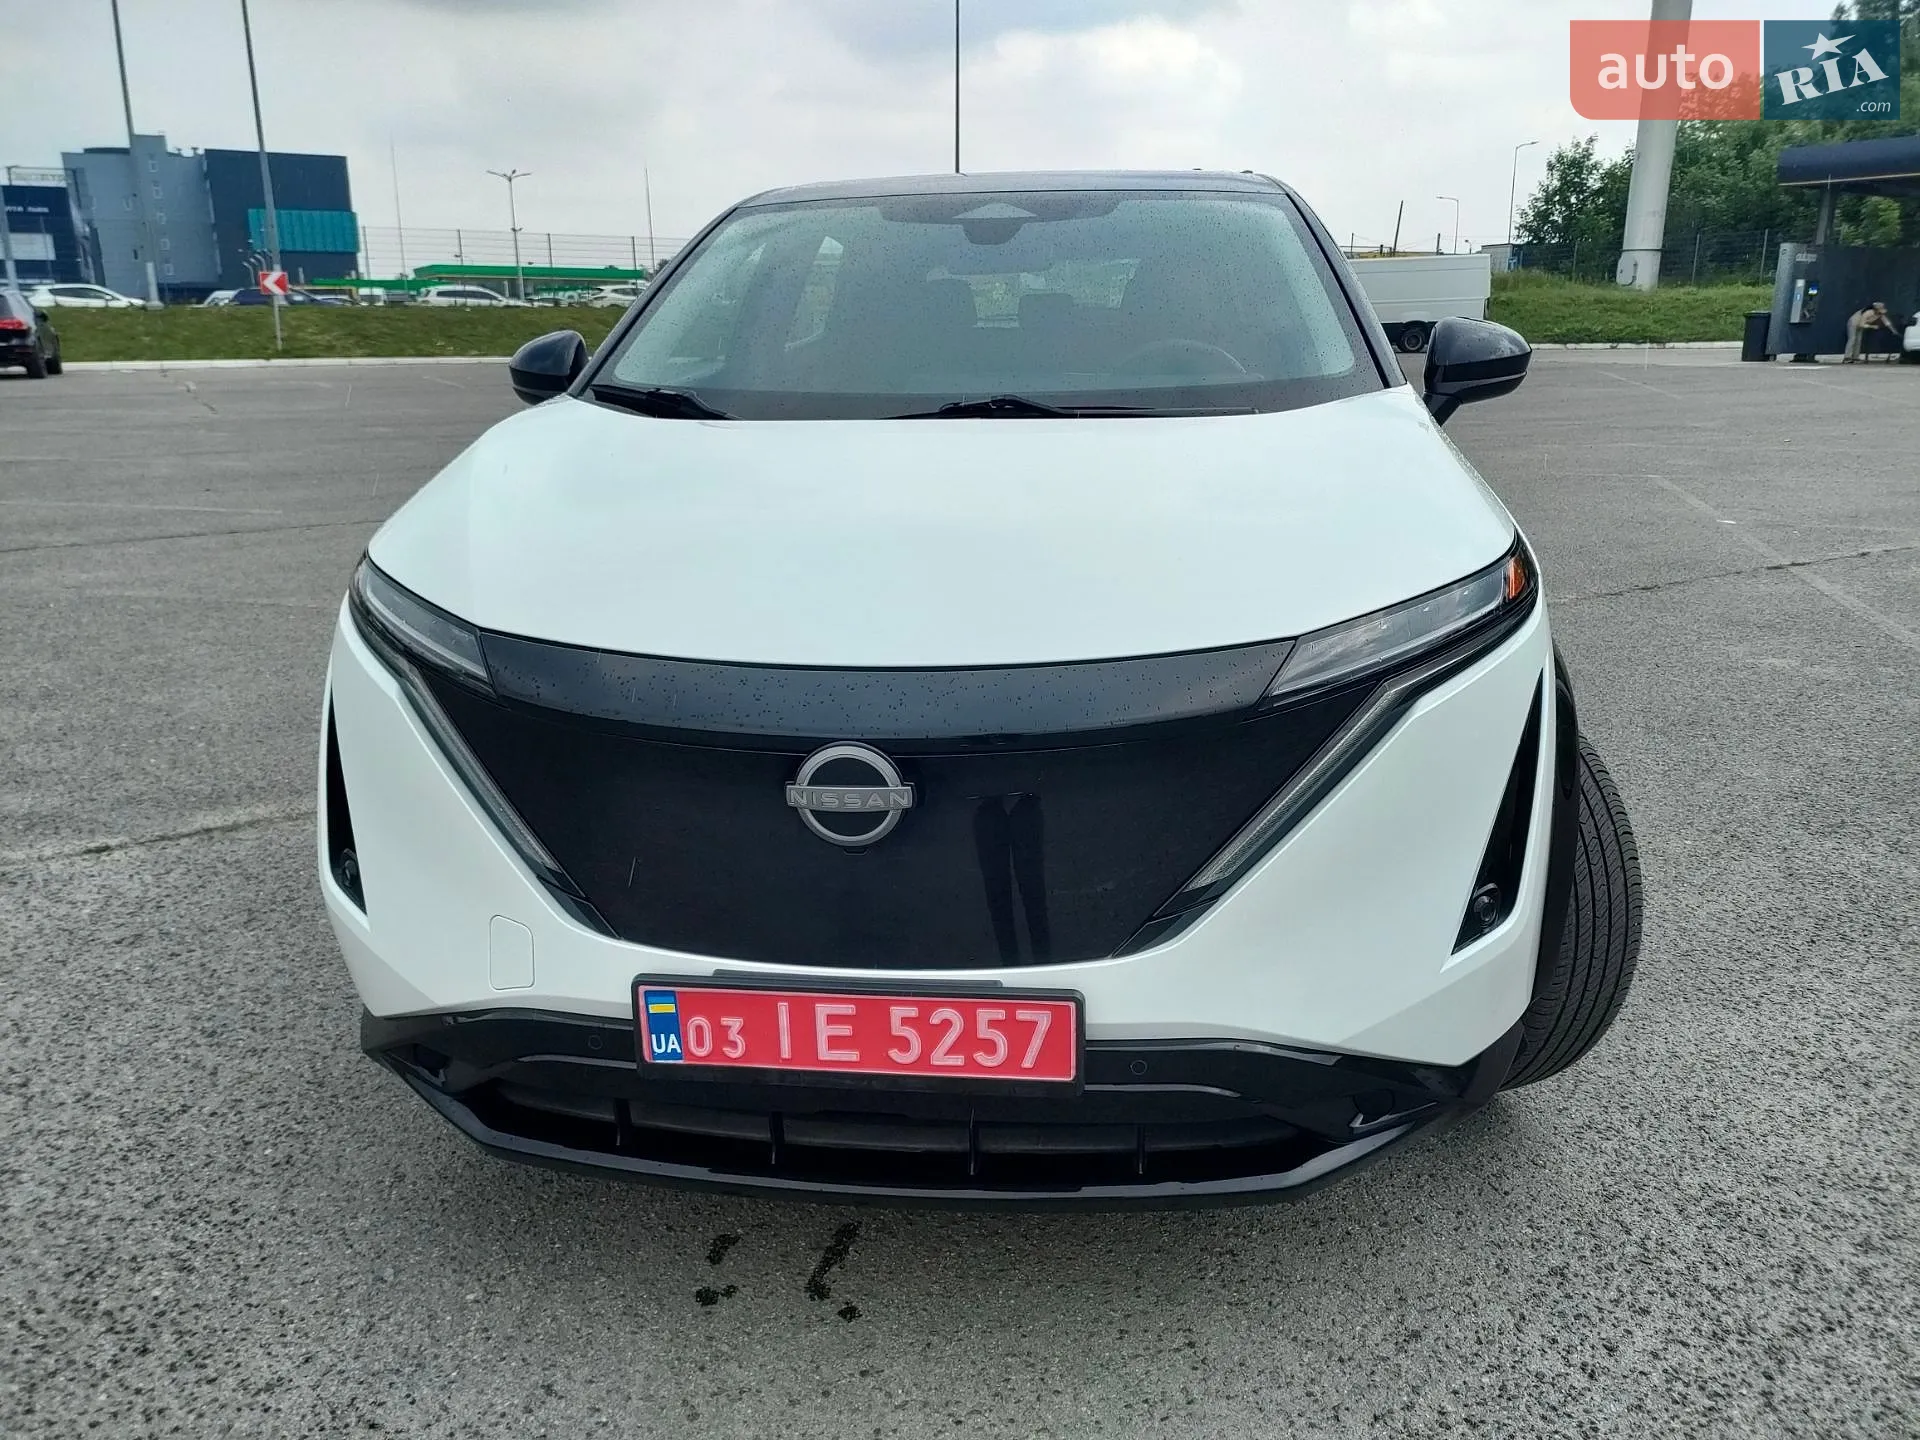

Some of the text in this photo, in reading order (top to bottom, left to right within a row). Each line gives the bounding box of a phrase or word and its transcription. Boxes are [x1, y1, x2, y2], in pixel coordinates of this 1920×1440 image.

[789, 789, 909, 809] NISSAN
[651, 1033, 682, 1054] UA
[686, 1001, 1053, 1069] 03 IE 5257
